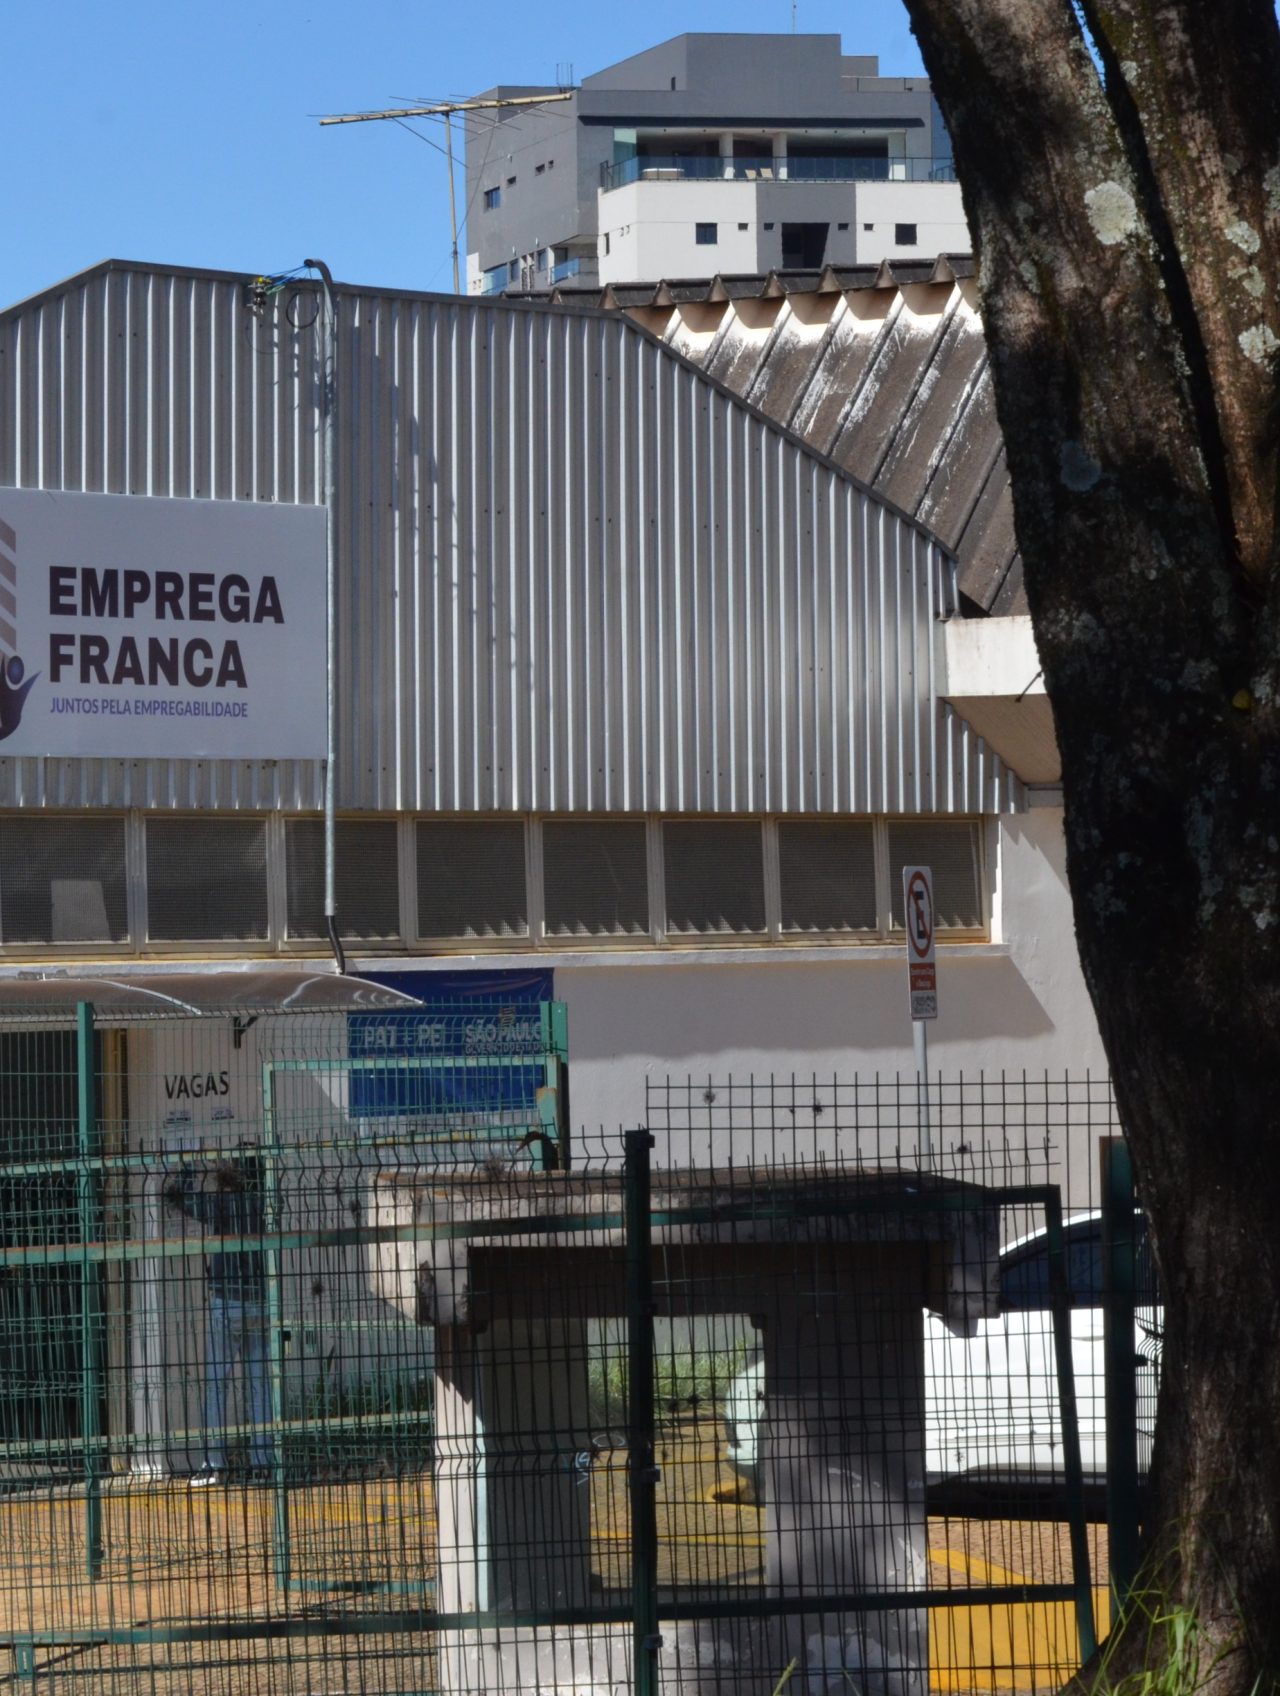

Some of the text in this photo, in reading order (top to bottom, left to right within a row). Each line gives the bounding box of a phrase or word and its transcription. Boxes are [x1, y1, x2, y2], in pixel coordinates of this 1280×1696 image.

[49, 565, 285, 624] EMPREGA
[49, 633, 248, 688] FRANCA
[50, 697, 248, 718] JUNTOS PELA EMPREGABILIDADE
[365, 1025, 397, 1047] PAT
[165, 1071, 229, 1099] VAGAS
